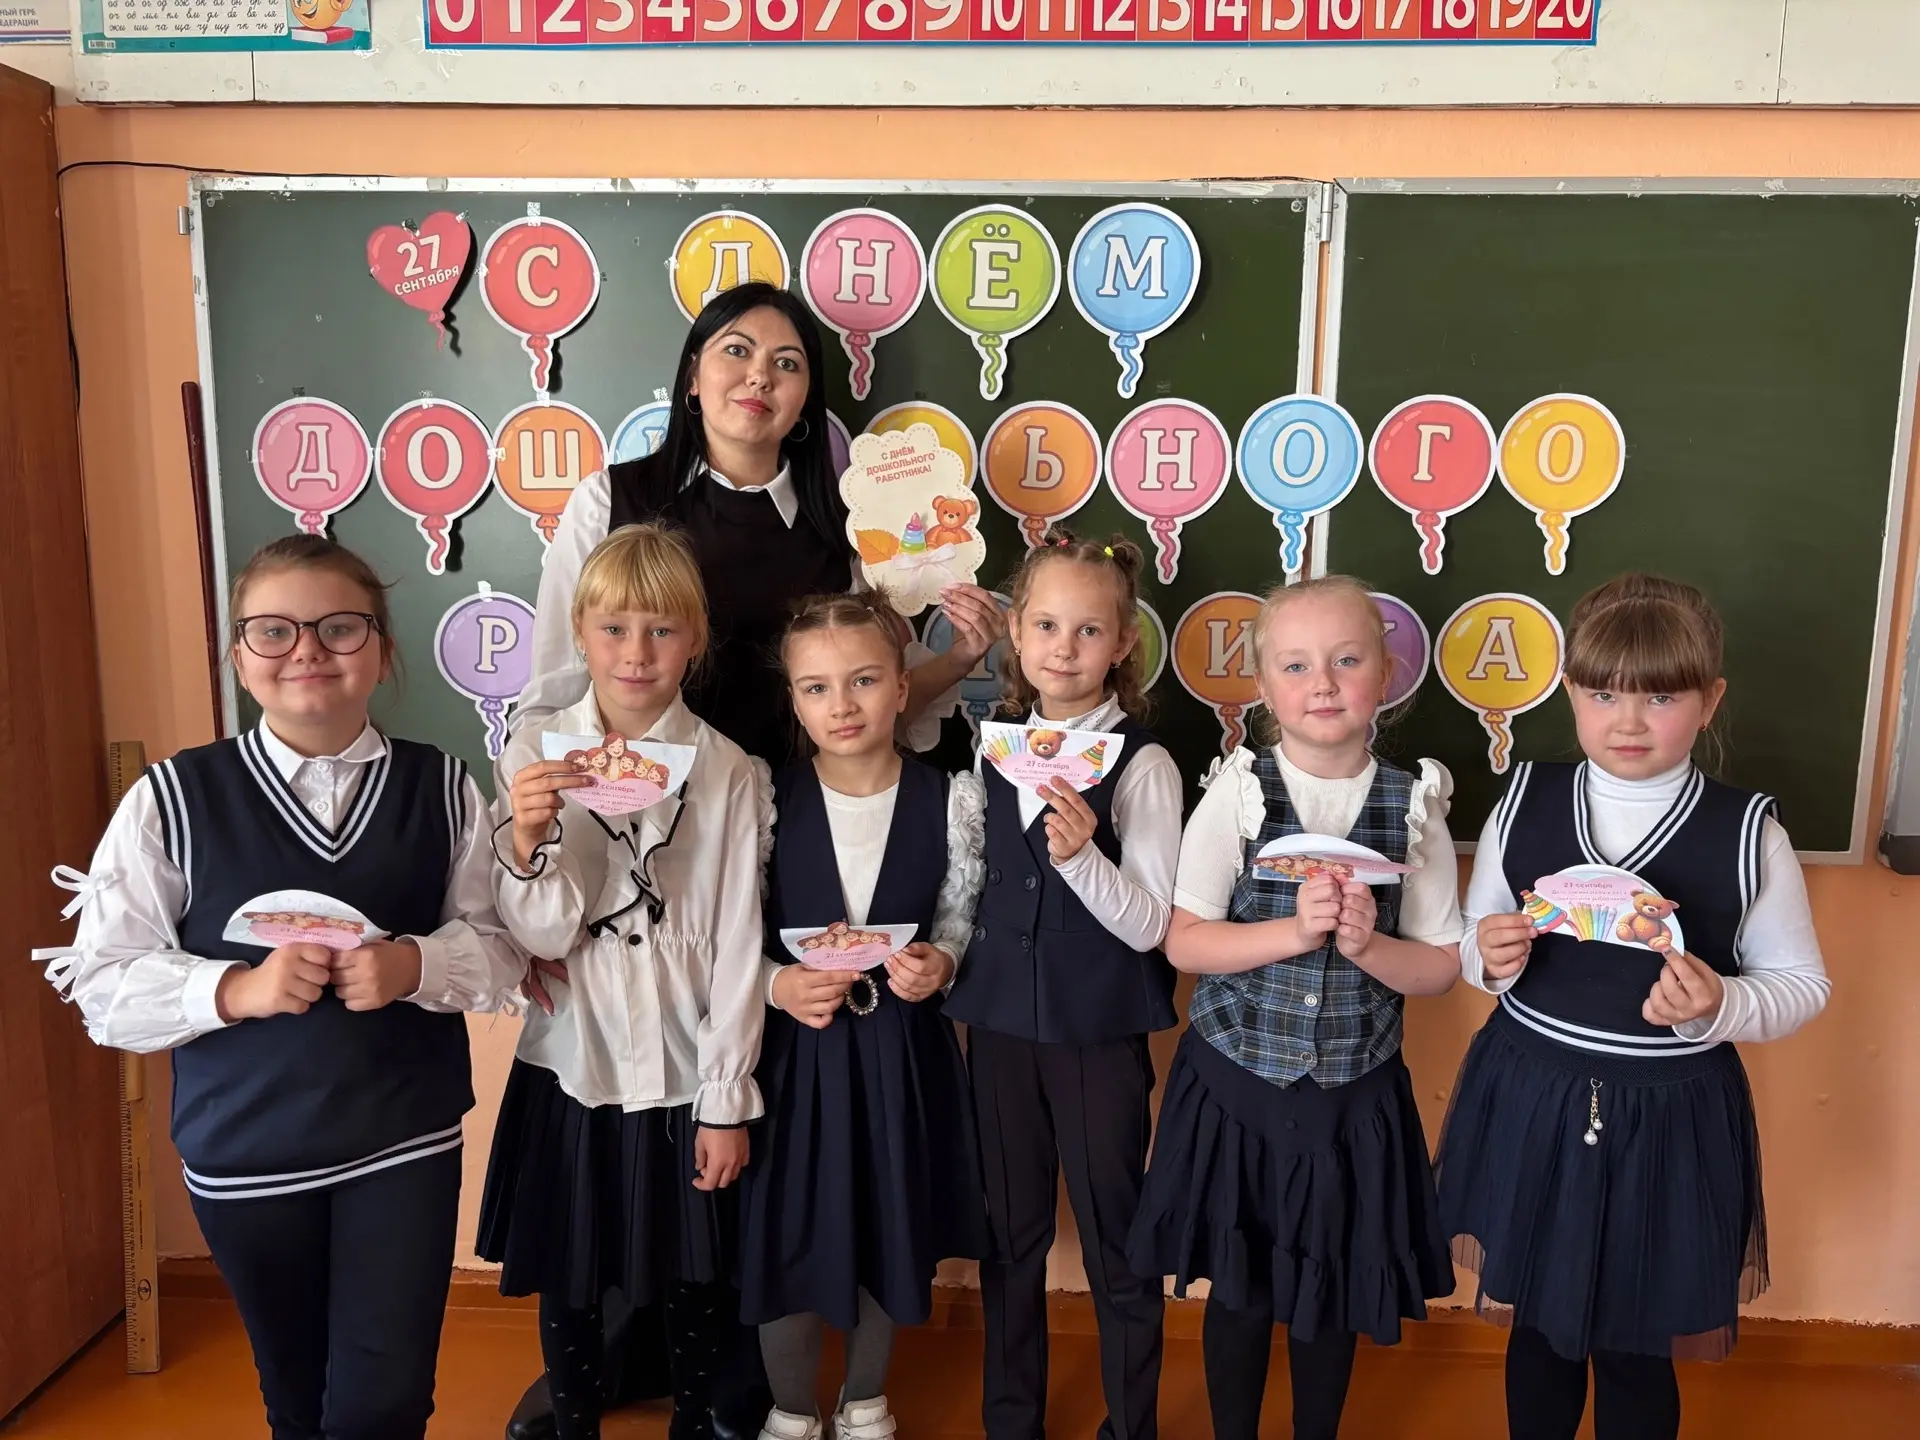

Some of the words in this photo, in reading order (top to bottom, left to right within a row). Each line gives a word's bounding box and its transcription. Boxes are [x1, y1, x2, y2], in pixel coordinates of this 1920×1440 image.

[19, 8, 36, 16] ГЕРБ
[397, 234, 440, 278] 27
[394, 265, 459, 296] сентября
[516, 246, 560, 308] С
[866, 452, 935, 477] ДОШКОЛЬНОГО
[881, 453, 888, 461] С
[890, 445, 915, 460] ДНЁМ
[876, 464, 932, 484] РАБОТНИКА!
